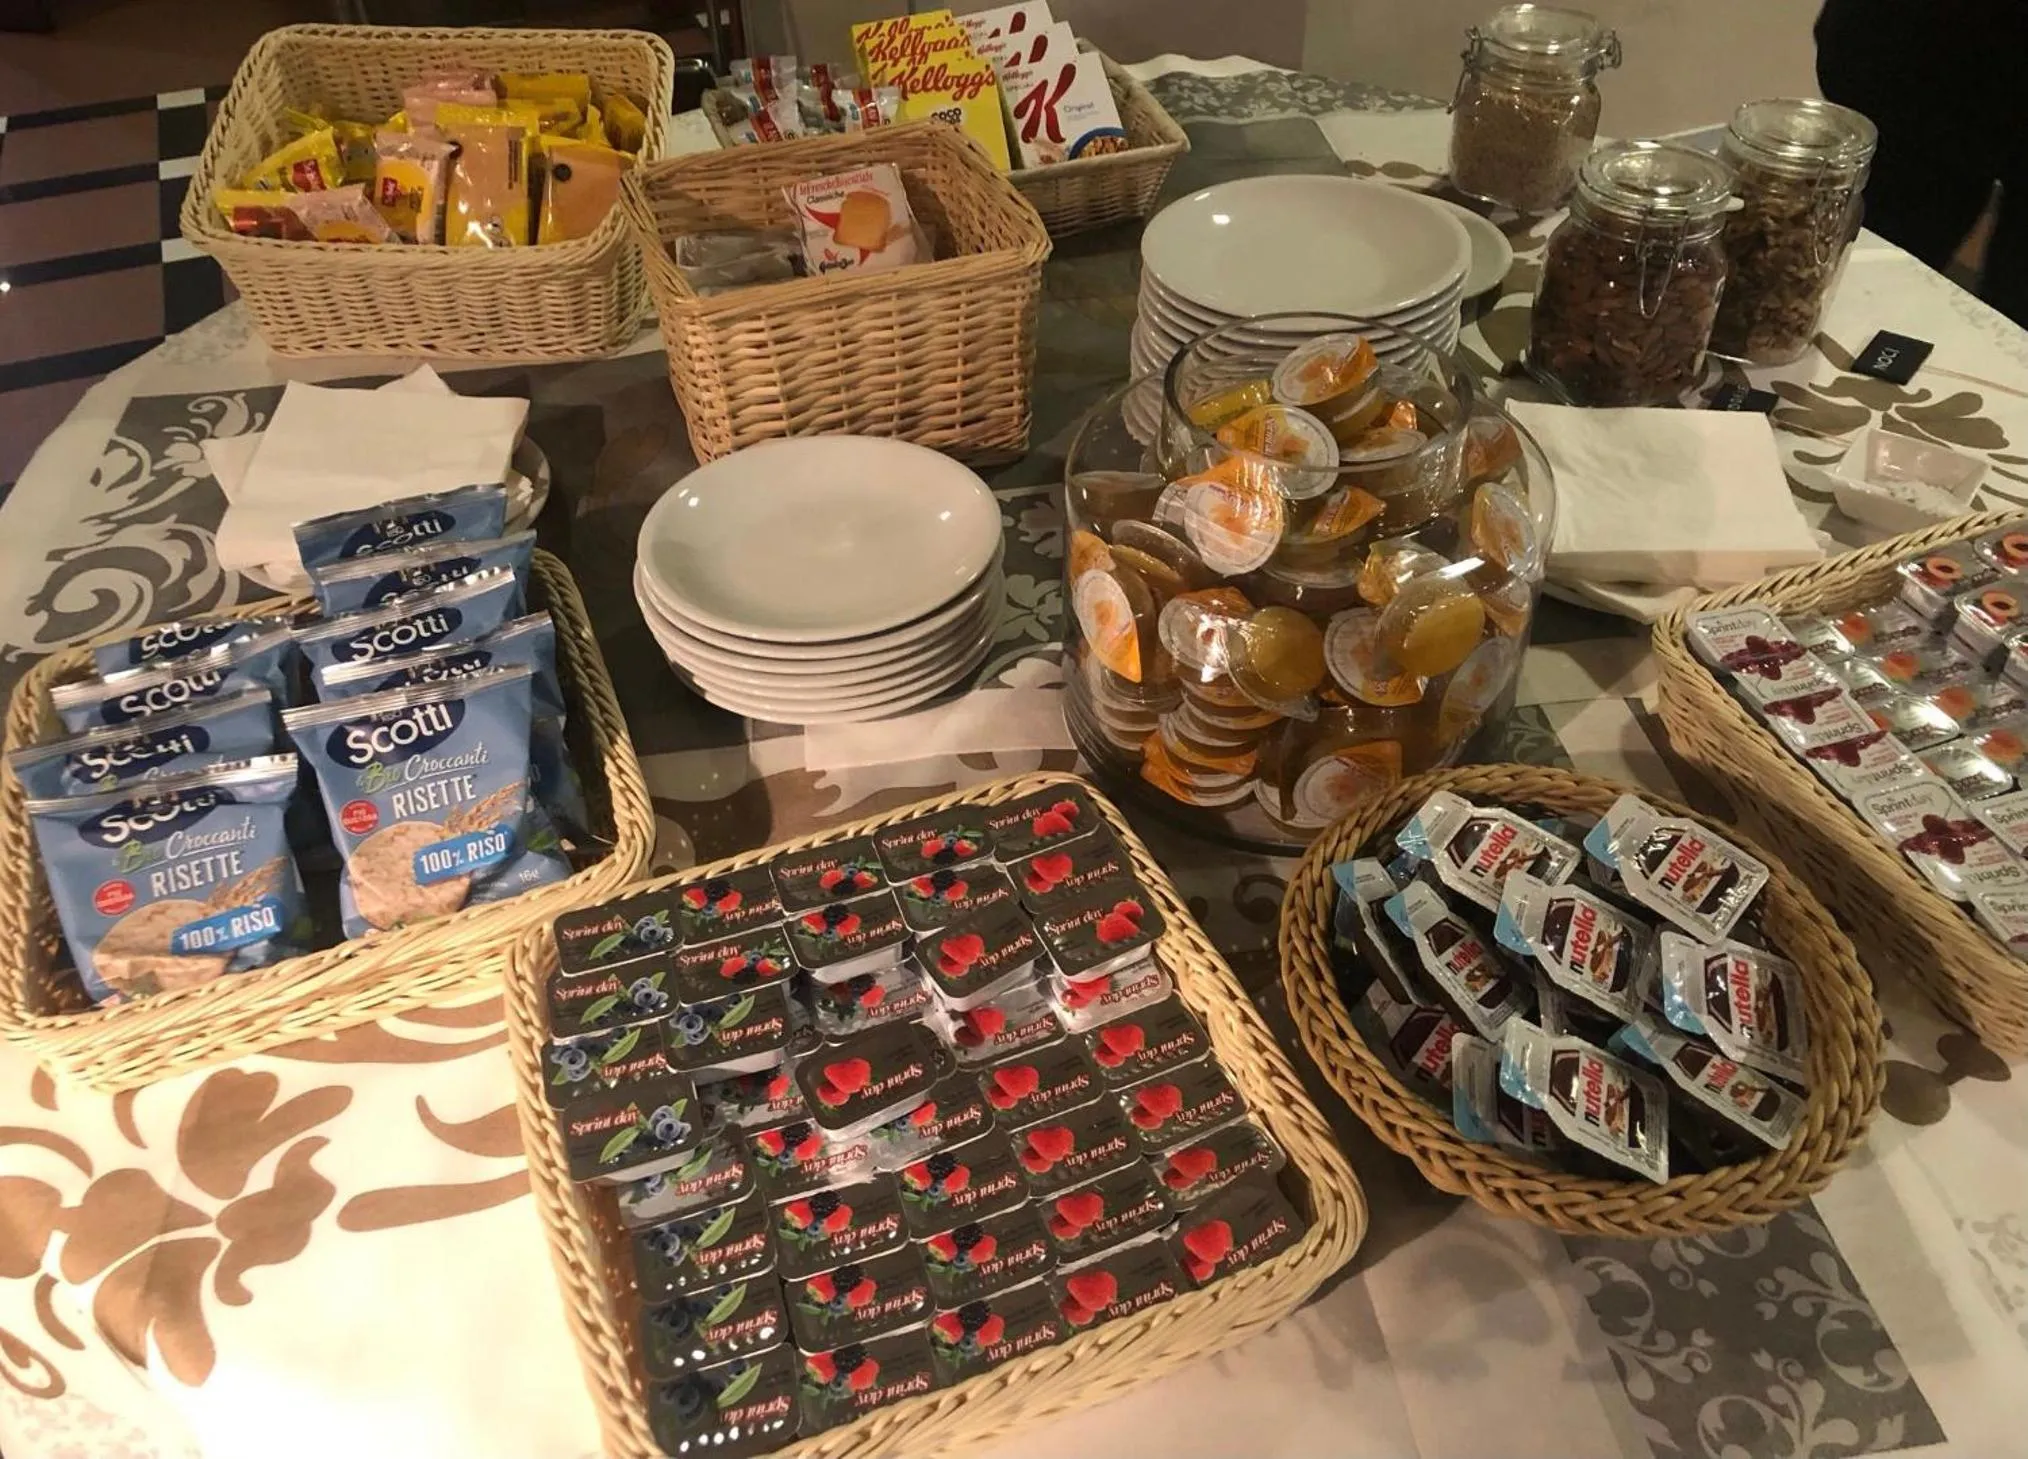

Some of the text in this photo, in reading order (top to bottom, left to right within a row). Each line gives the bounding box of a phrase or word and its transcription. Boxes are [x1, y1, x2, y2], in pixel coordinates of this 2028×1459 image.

[888, 63, 995, 100] Kellogg's
[350, 613, 451, 663] Scotti
[347, 702, 453, 764] Scotti
[403, 741, 489, 782] Croccanti
[392, 773, 477, 819] RISETTE
[166, 816, 256, 859] Croccanti
[419, 831, 507, 874] 100% RISO
[1469, 823, 1519, 878] nutella
[150, 850, 244, 897] RISETTE
[1658, 835, 1707, 891] nutella
[178, 906, 276, 950] 100% RISO
[1569, 902, 1599, 975] nutella
[1729, 958, 1754, 1039] nutella
[1582, 1054, 1605, 1126] nutella
